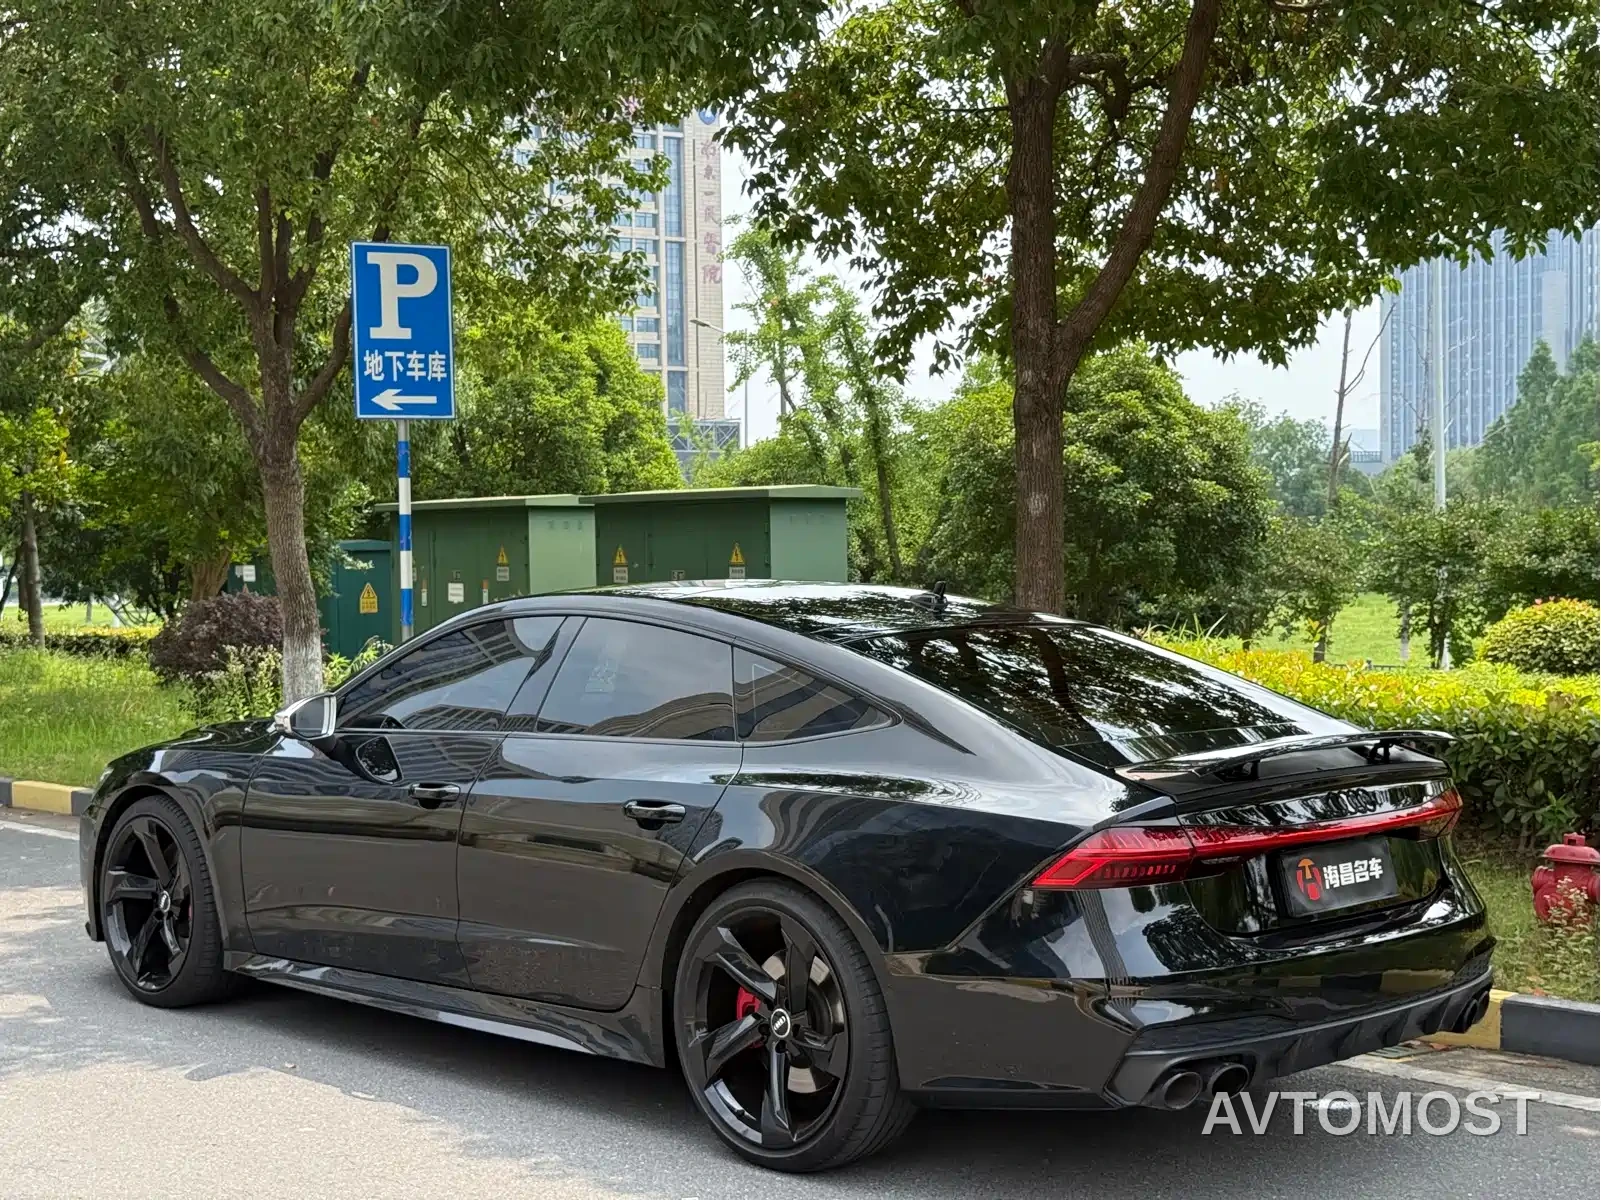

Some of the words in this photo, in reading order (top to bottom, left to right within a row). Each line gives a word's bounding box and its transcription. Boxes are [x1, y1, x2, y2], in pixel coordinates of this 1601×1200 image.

[366, 251, 438, 340] P
[363, 349, 448, 382] 地下车库
[1322, 857, 1384, 890] 海昌名车
